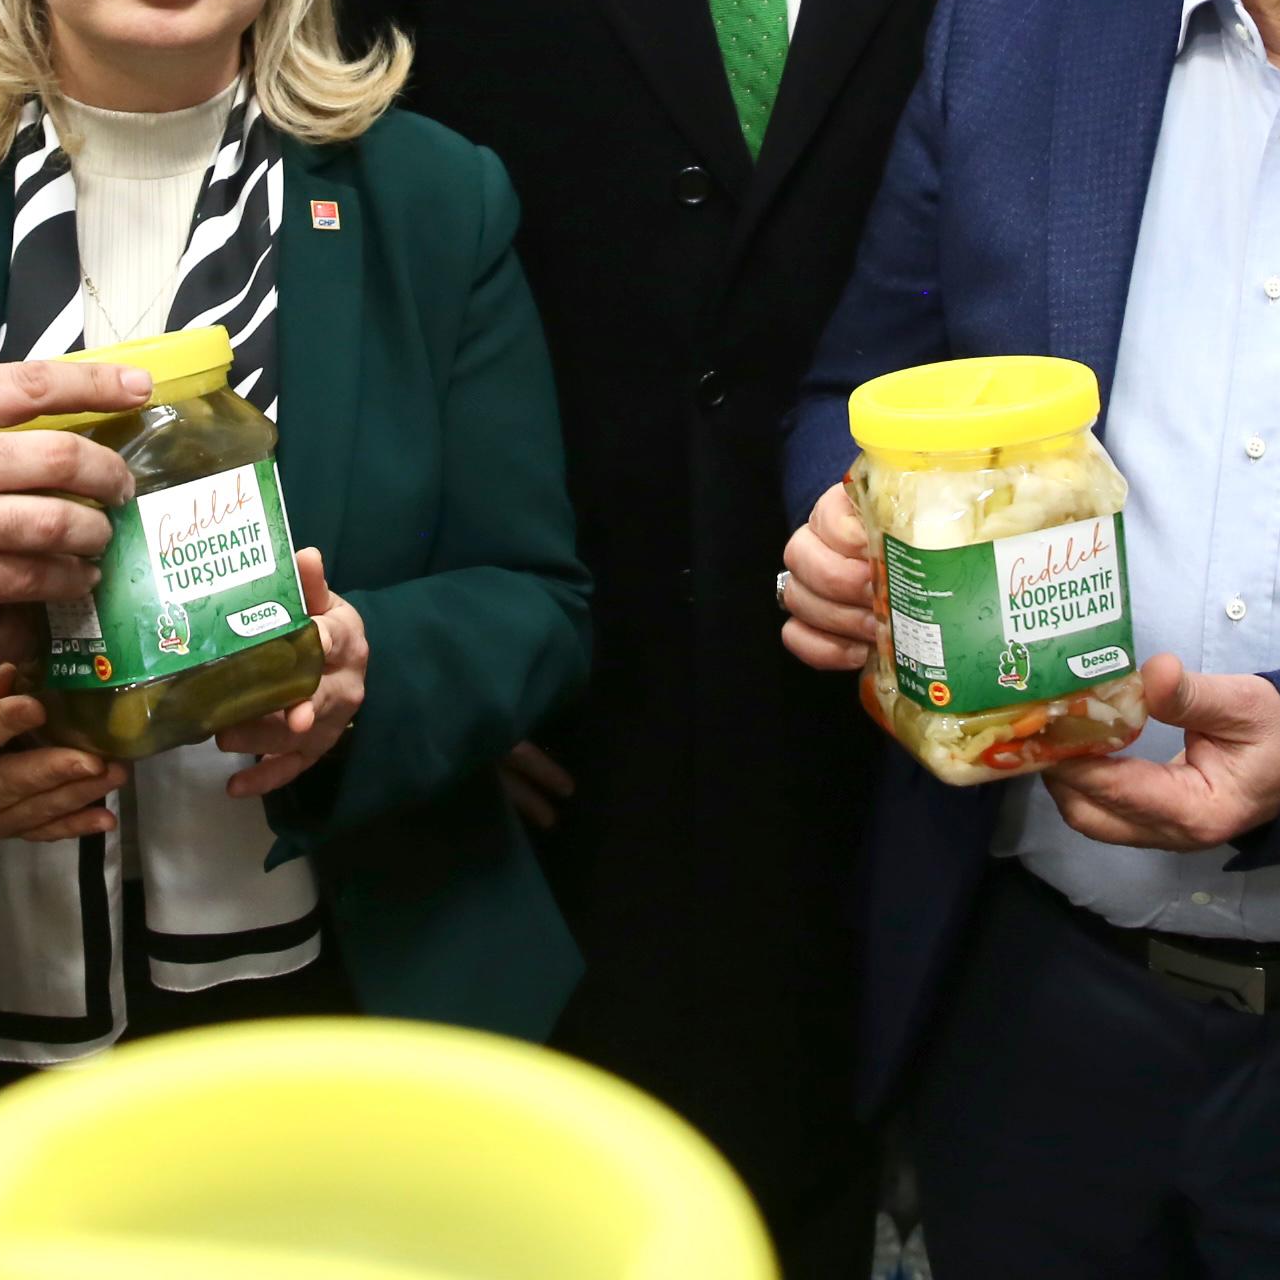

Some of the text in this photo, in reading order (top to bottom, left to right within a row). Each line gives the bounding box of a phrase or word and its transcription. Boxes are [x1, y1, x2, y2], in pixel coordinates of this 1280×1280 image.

[159, 519, 261, 569] KOOPERATİF
[163, 545, 267, 592] TURŞULARI
[1009, 567, 1112, 611] KOOPERATİF
[240, 605, 278, 625] besaş
[1010, 592, 1115, 632] TURŞULARI
[1081, 649, 1119, 668] besaş
